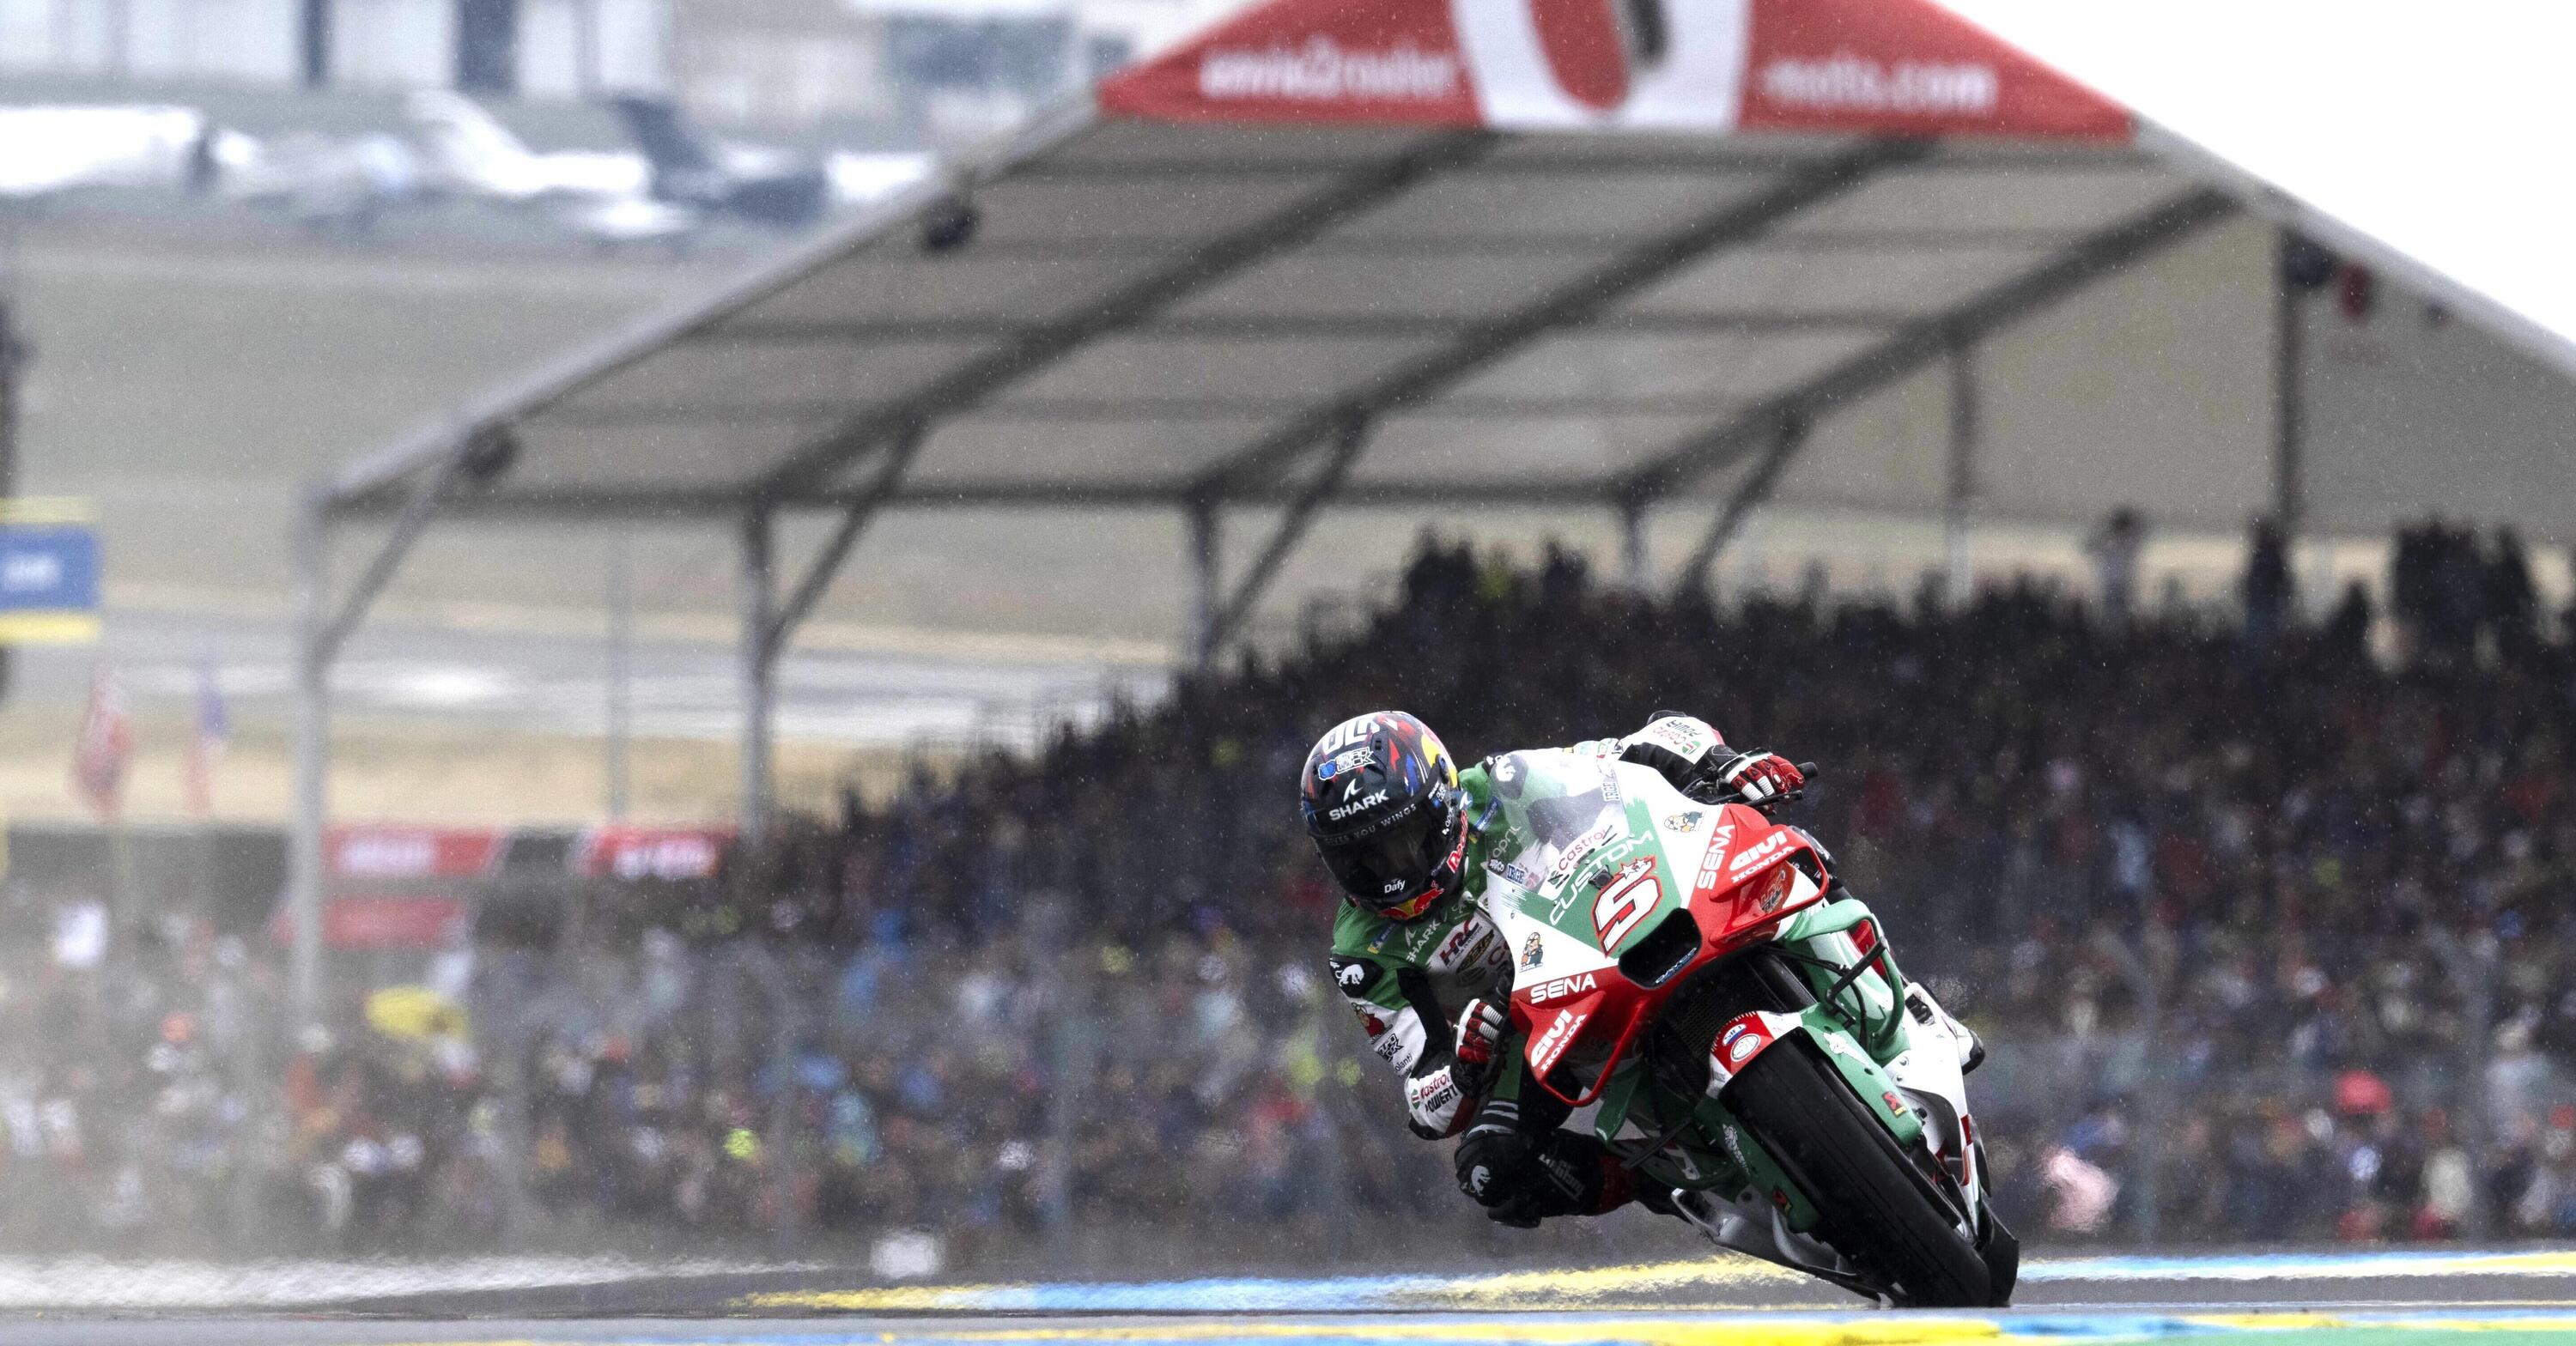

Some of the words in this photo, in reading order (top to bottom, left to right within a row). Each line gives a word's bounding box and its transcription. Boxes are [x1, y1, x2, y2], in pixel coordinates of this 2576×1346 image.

[1329, 789, 1389, 821] SHARK
[1381, 803, 1417, 827] WINGS
[1697, 825, 1735, 890] SENA
[1729, 831, 1788, 871] GIVI
[1731, 846, 1796, 883] HONDA
[1384, 879, 1406, 894] Dafy
[1550, 829, 1655, 926] CUSTOM
[1592, 855, 1663, 959] 5
[1439, 915, 1479, 967] HRC
[1530, 973, 1597, 1004] SENA
[1530, 1009, 1573, 1068] GIVI
[1540, 1014, 1588, 1072] HONDA
[1393, 1052, 1413, 1073] olanti
